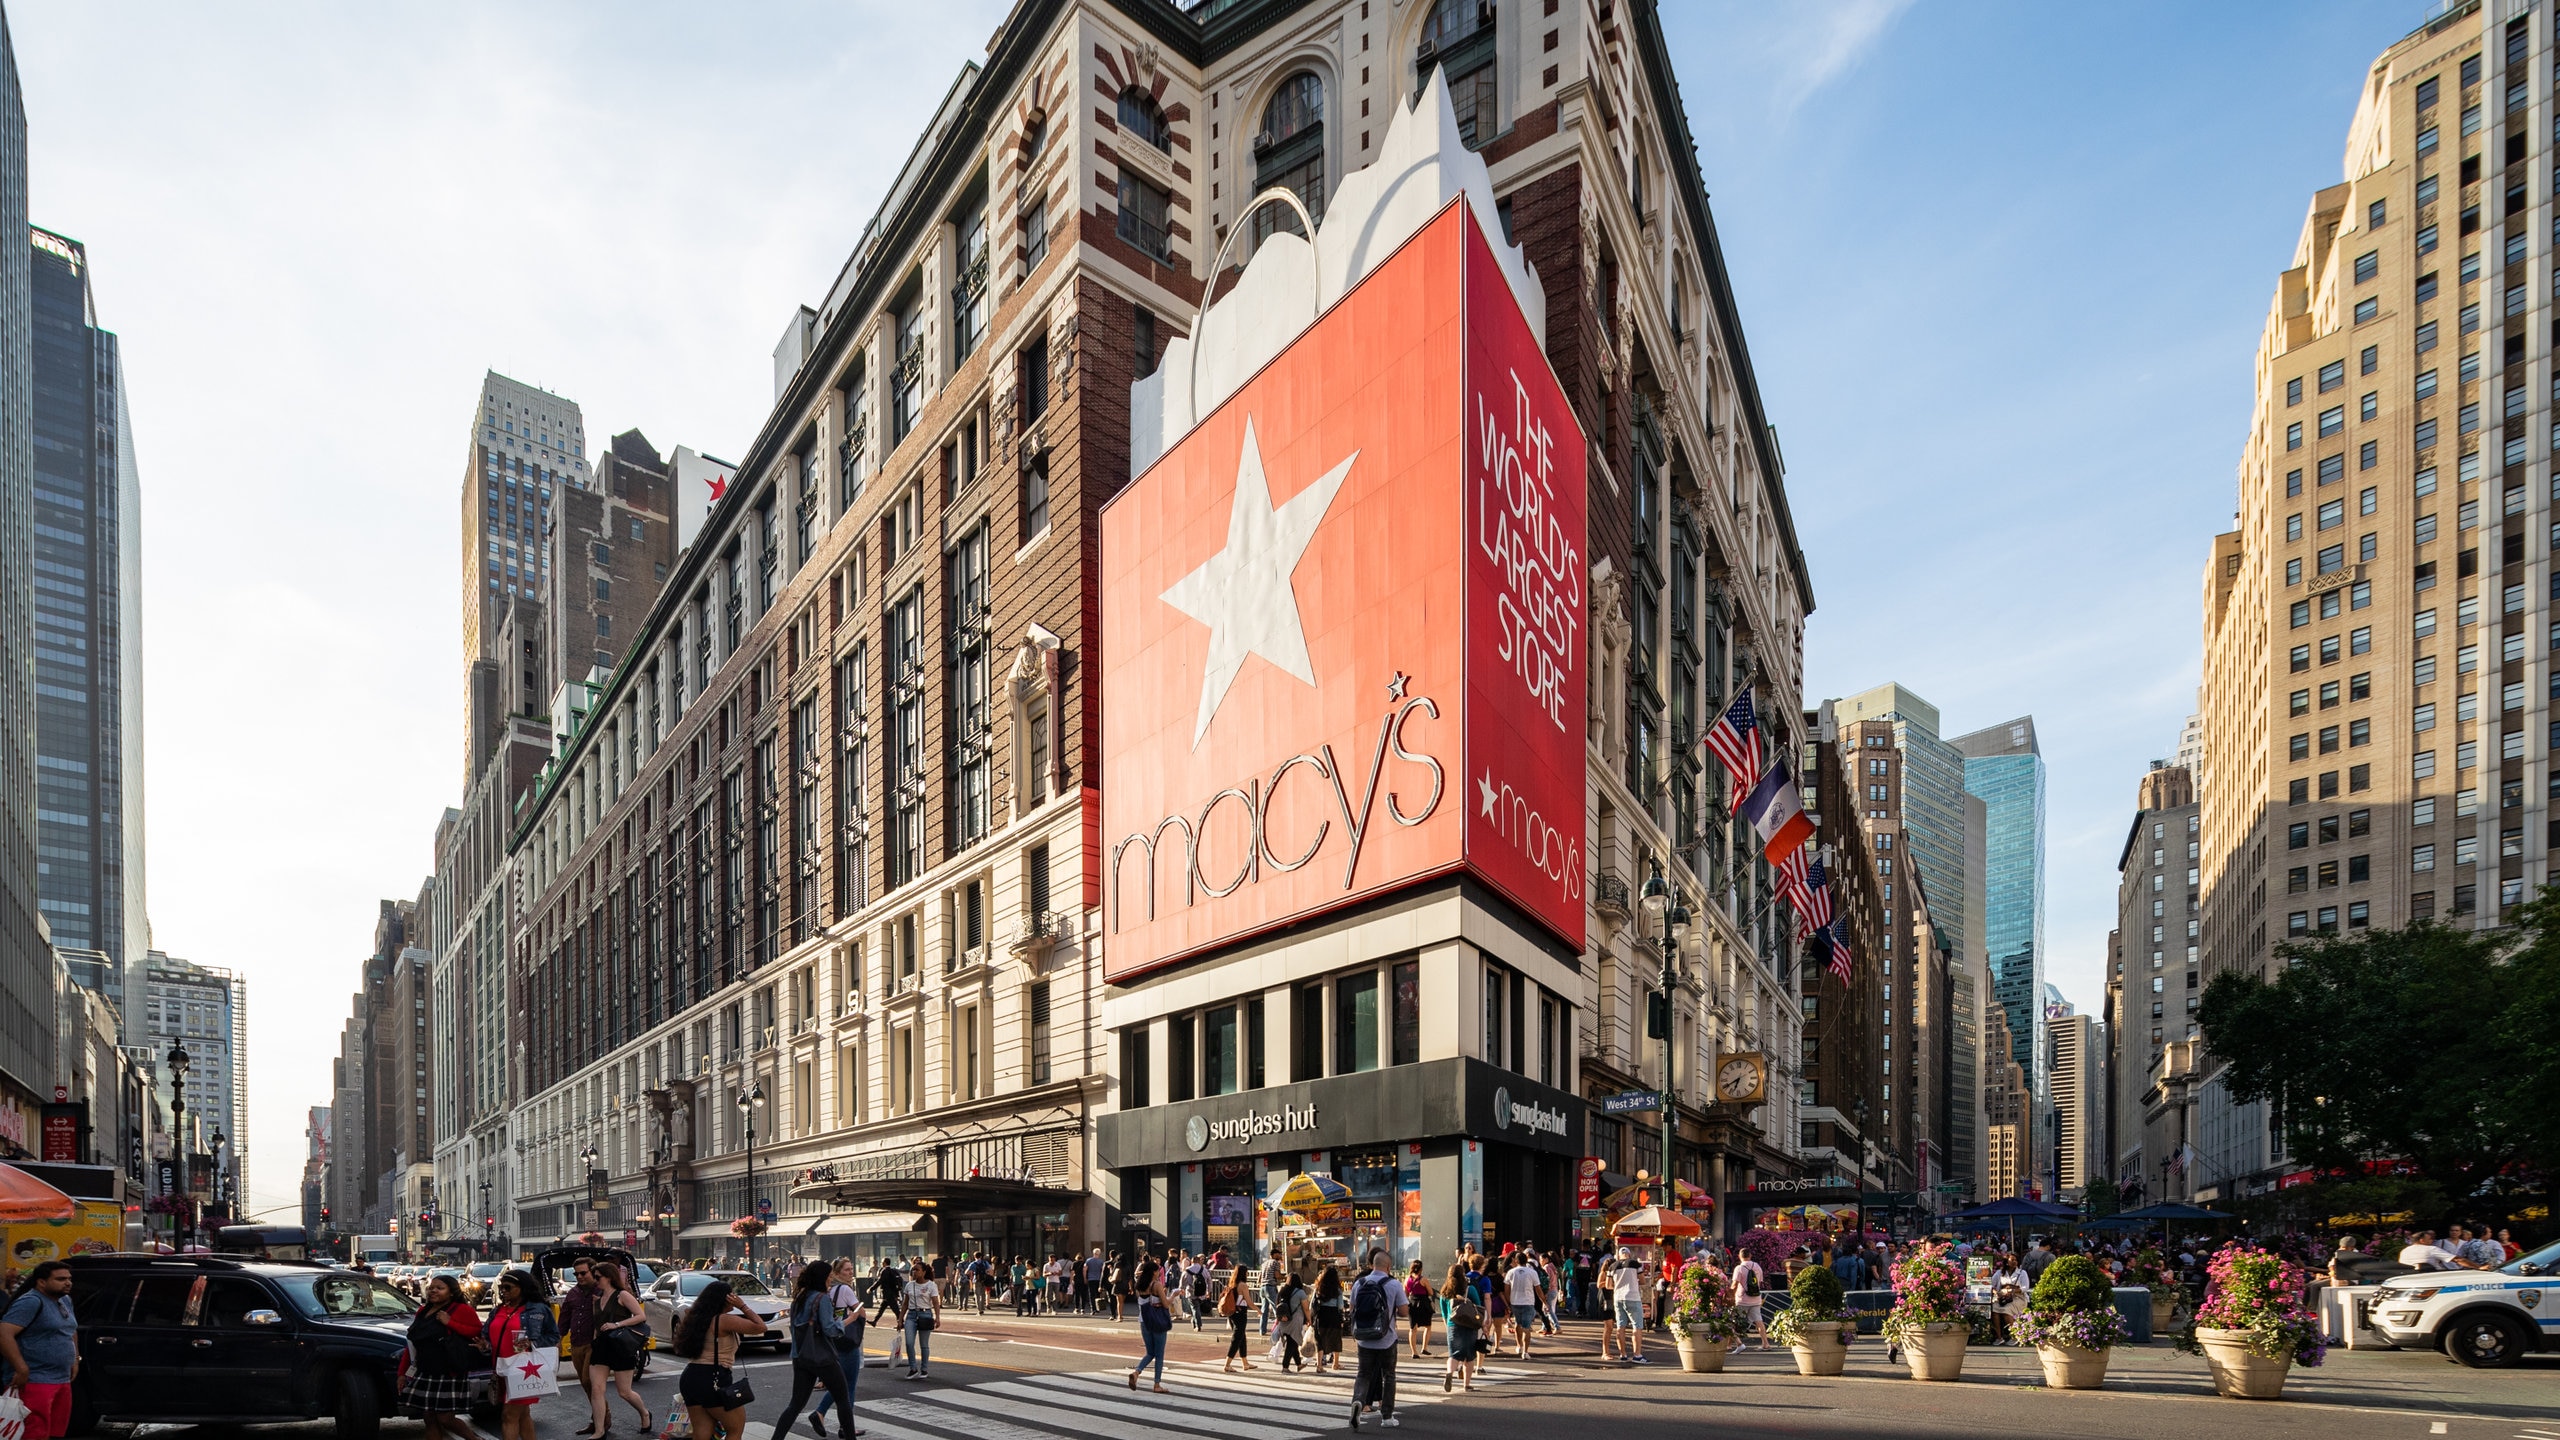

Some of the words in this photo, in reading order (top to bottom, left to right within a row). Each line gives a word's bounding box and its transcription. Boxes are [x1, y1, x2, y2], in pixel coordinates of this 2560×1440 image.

[1510, 367, 1554, 500] THE
[1478, 391, 1579, 608] WORLD'S
[1480, 477, 1578, 672] LARGEST
[1498, 592, 1566, 733] STORE
[1112, 670, 1444, 935] macy's
[1512, 1100, 1551, 1136] sunglass
[1551, 1106, 1567, 1137] hut
[1606, 1100, 1628, 1110] West
[1629, 1096, 1645, 1108] 34th
[1646, 1096, 1656, 1106] St
[1210, 1109, 1283, 1144] sunglass
[1285, 1103, 1317, 1131] hut
[133, 1137, 142, 1167] KAY
[161, 1167, 172, 1184] OLD
[1284, 1197, 1321, 1207] SABRETT
[2467, 1283, 2504, 1291] POLICE
